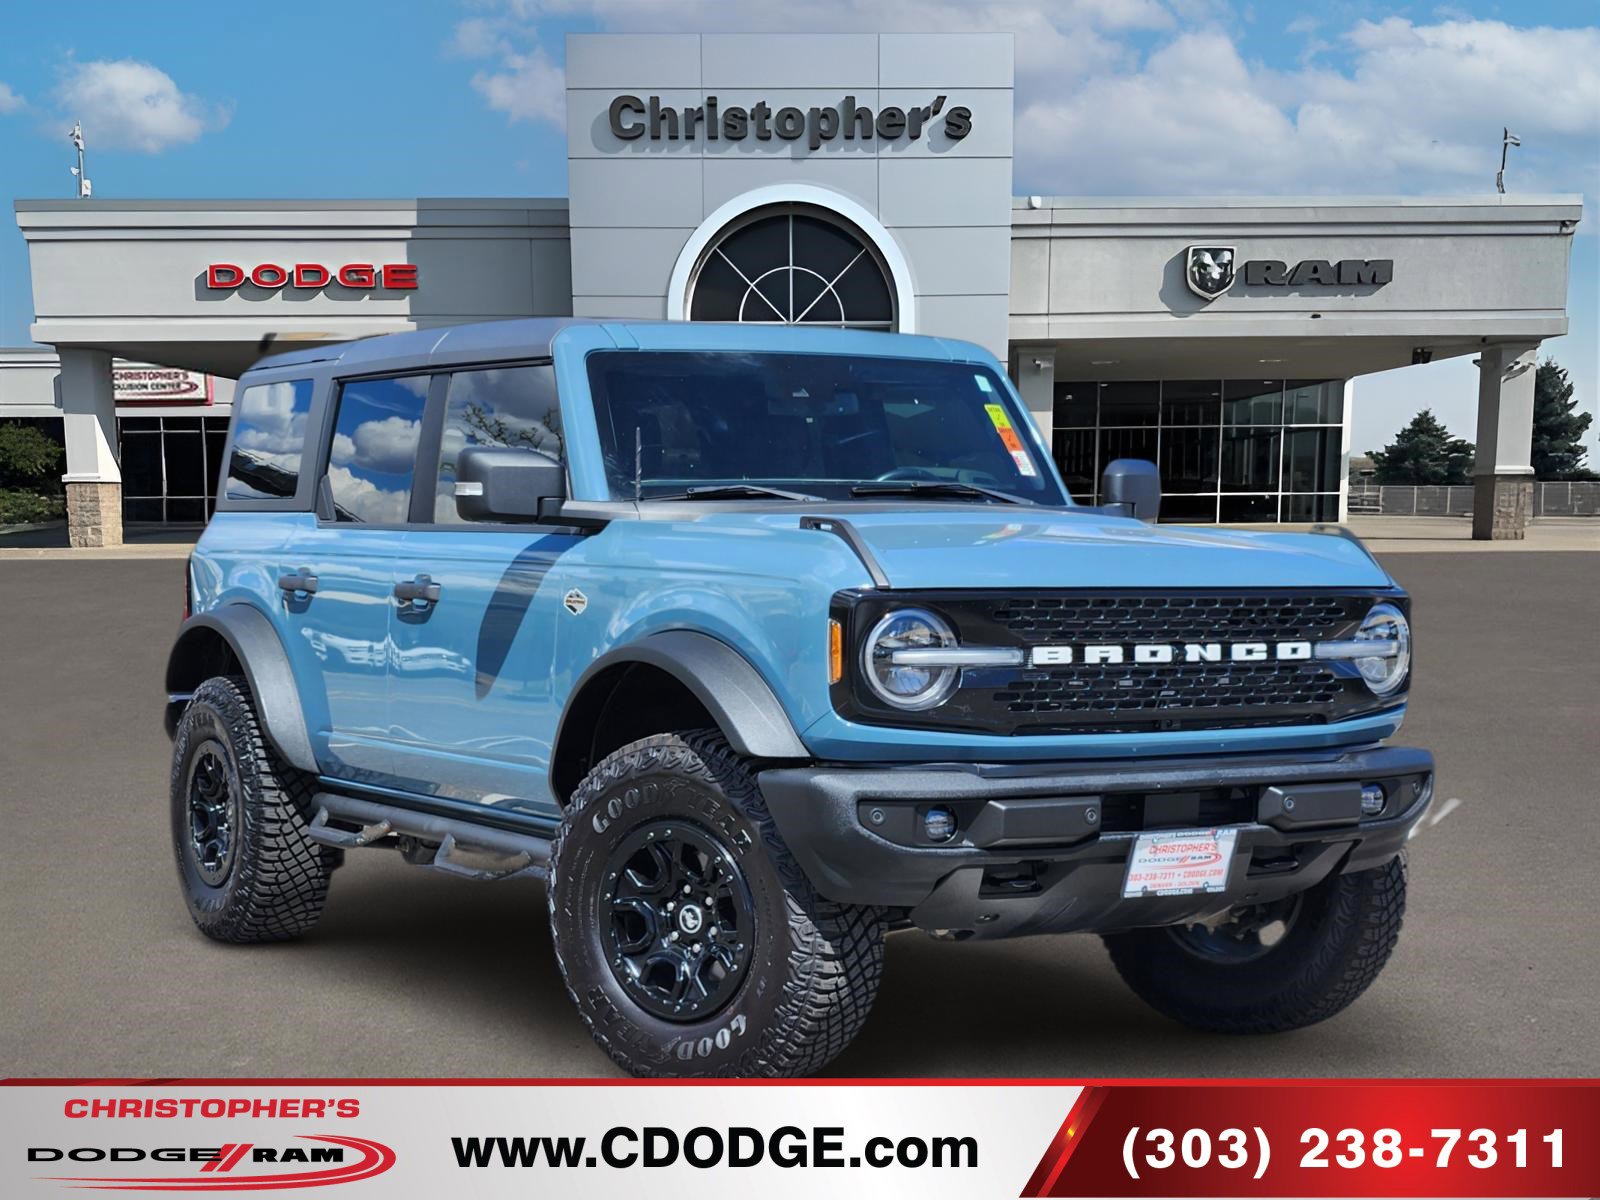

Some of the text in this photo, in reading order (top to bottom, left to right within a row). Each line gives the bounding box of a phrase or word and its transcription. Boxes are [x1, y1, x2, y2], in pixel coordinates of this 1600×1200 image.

[608, 95, 972, 150] Christopher's
[206, 263, 418, 289] DODGE
[1245, 259, 1394, 285] RAM
[112, 371, 189, 381] CHRISTOPHER'S
[112, 383, 149, 391] OLLISION
[1032, 641, 1312, 665] BRONCO
[1149, 842, 1217, 855] CHRISTOPHER'S
